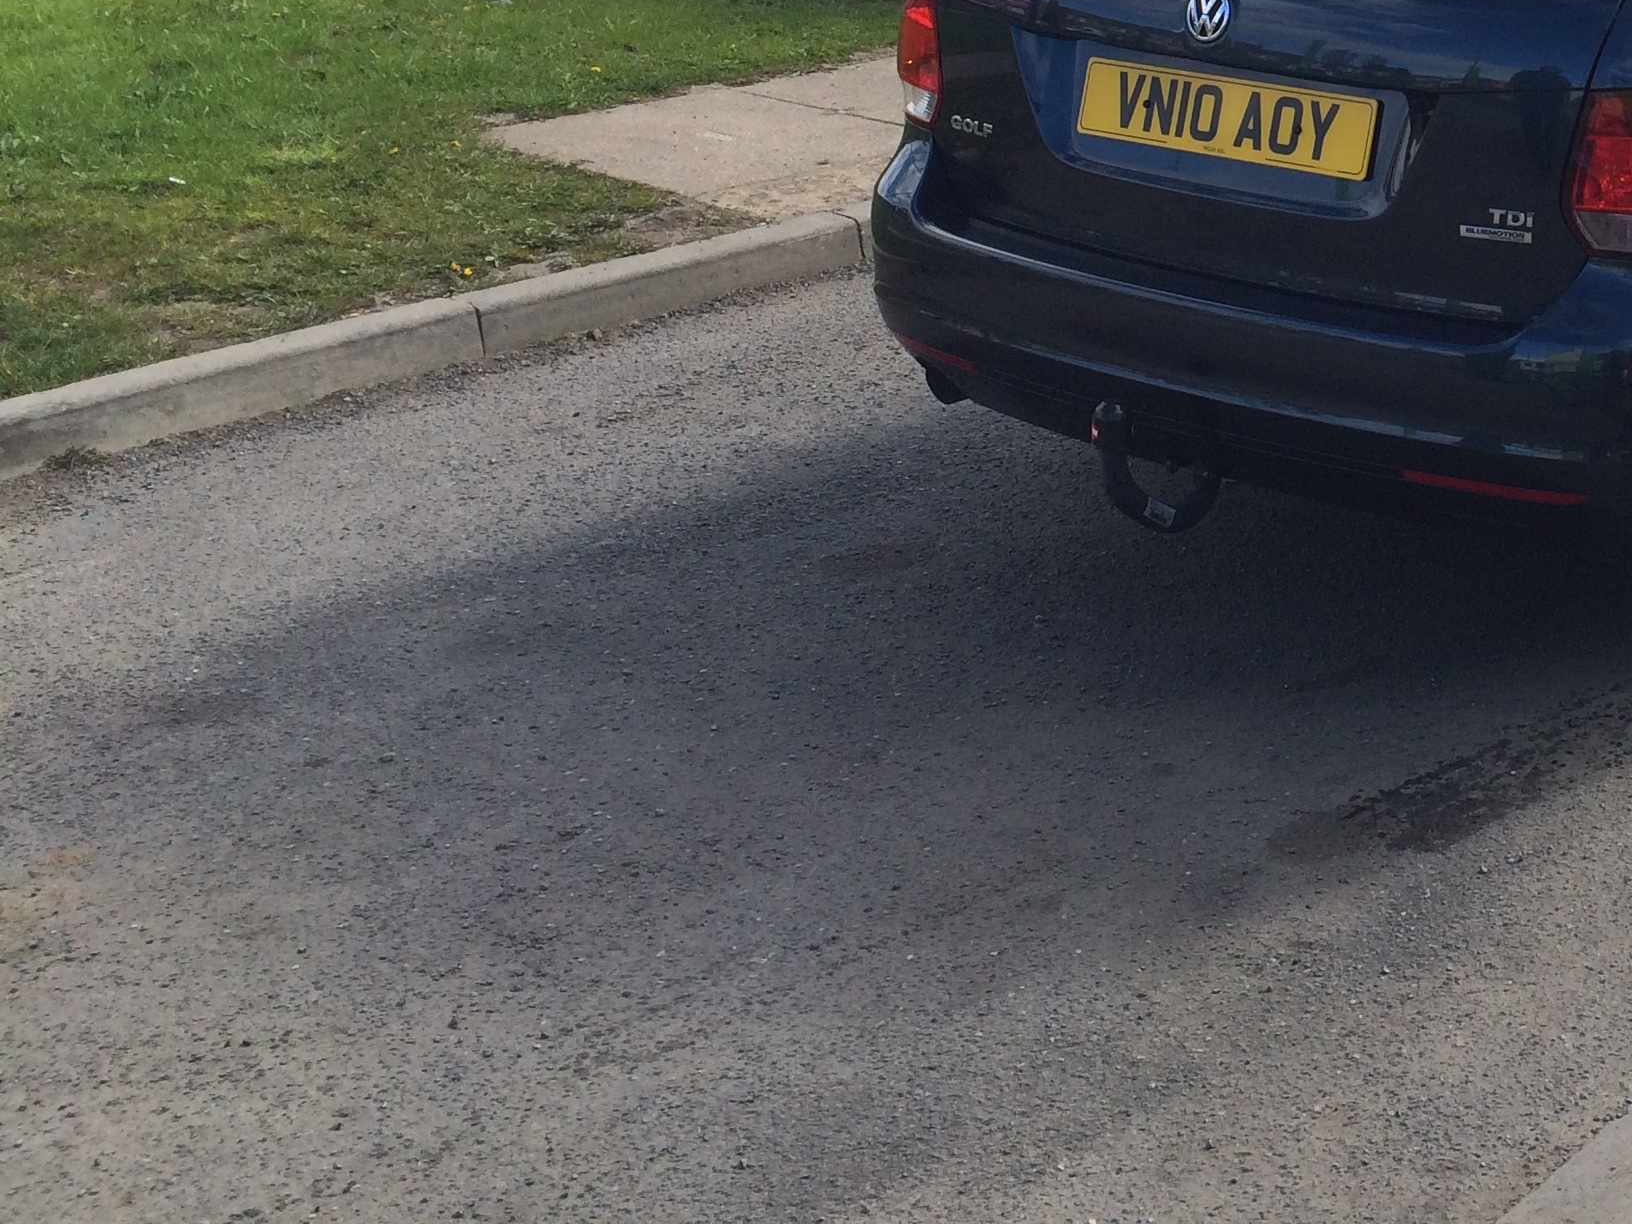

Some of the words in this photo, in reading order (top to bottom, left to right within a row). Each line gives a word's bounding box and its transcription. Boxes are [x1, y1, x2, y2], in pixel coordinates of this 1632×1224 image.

[950, 114, 993, 138] GOLF
[1119, 71, 1223, 143] VN10
[1233, 91, 1341, 162] AOY
